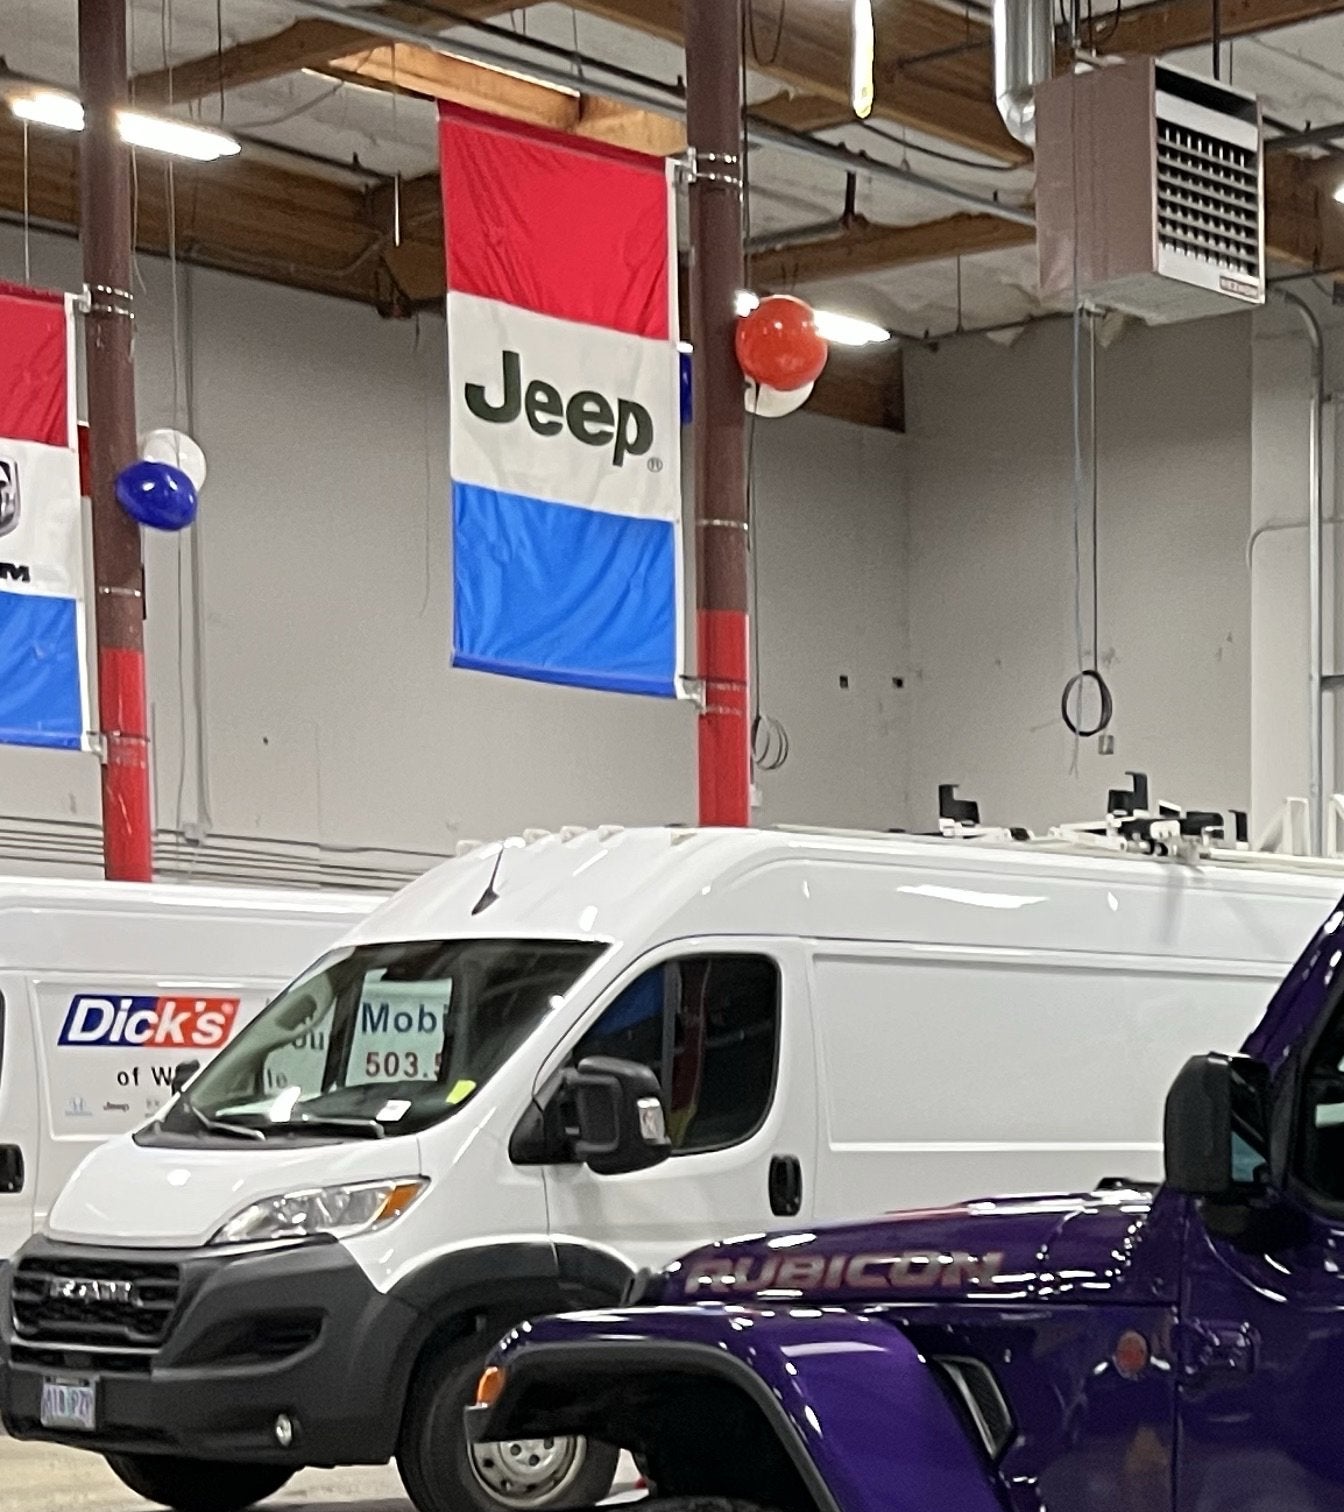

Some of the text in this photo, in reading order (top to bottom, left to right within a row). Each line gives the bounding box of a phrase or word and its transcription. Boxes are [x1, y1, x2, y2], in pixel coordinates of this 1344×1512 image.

[464, 350, 654, 467] Jeep
[67, 998, 226, 1046] Dick's
[117, 1066, 139, 1087] of
[685, 1251, 1003, 1292] RUBICON
